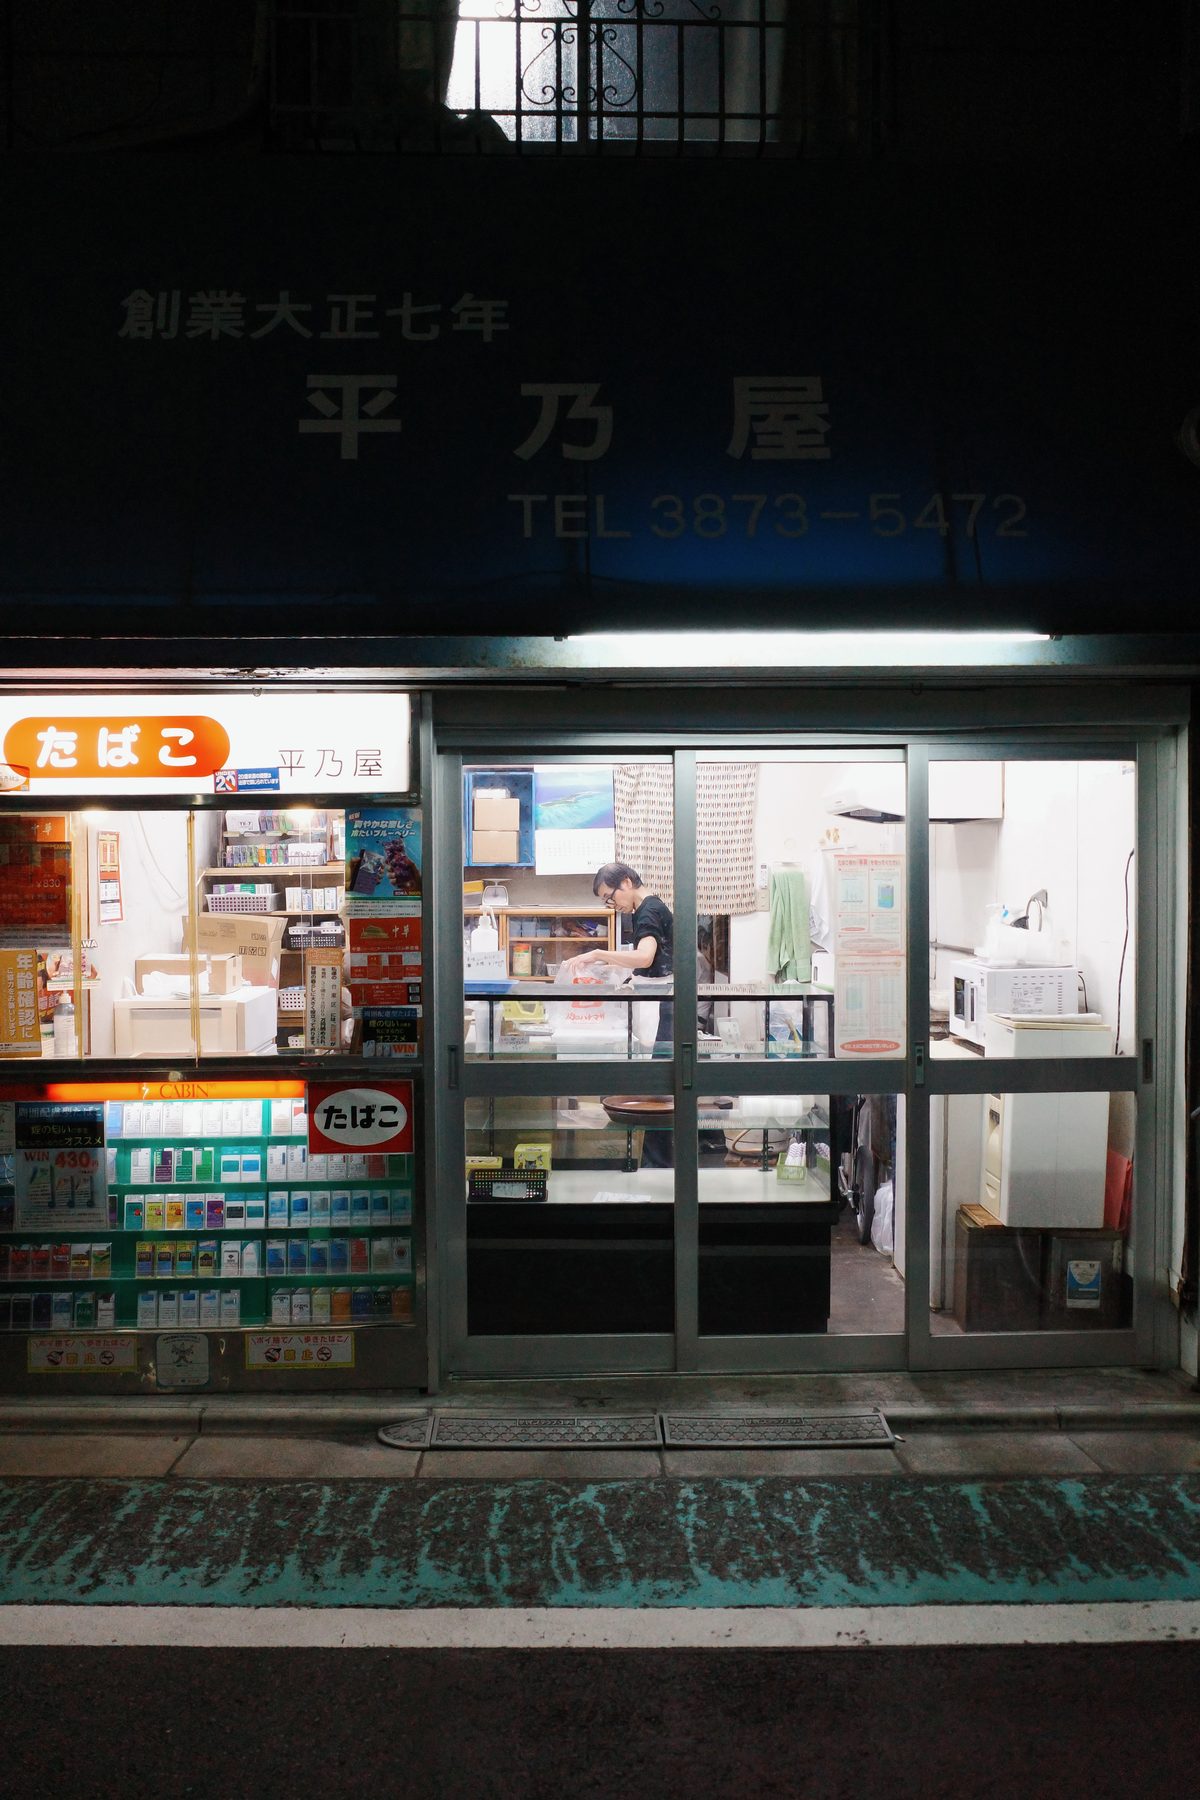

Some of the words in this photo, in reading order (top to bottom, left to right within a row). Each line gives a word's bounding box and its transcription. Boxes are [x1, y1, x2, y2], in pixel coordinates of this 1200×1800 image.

[118, 288, 511, 343] 創業大正七年
[297, 373, 833, 461] 平乃屋
[506, 494, 632, 540] TEL
[35, 724, 198, 769] たばこ
[278, 749, 383, 777] 平乃屋
[16, 954, 36, 1038] 年齢確認に
[393, 1044, 417, 1054] WIN
[160, 1083, 209, 1099] CABIN
[323, 1105, 399, 1130] たばこ
[24, 1152, 50, 1162] WIN
[304, 1335, 344, 1343] 歩きたばこ
